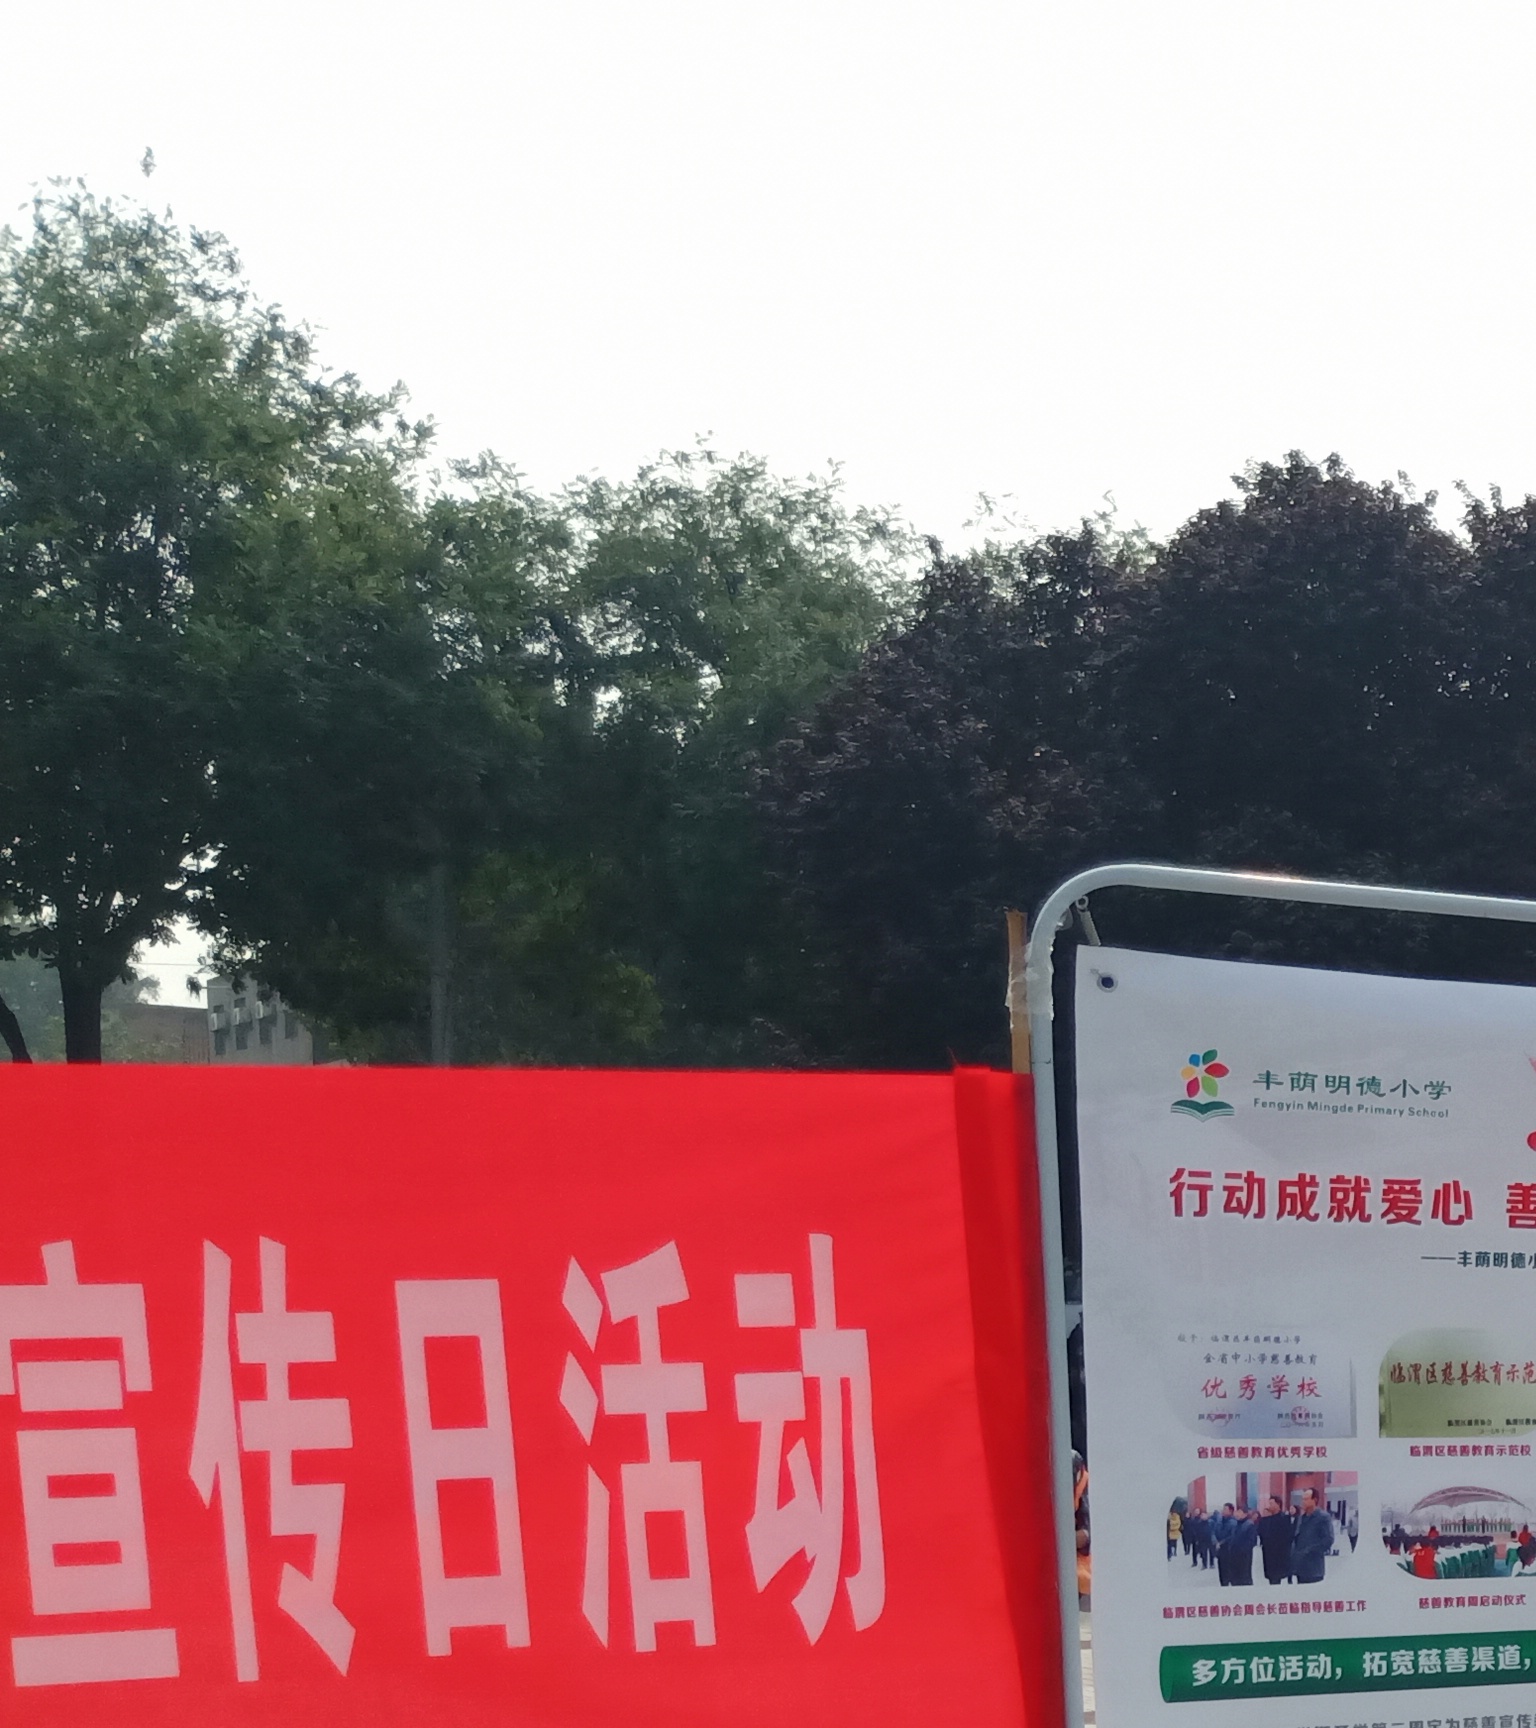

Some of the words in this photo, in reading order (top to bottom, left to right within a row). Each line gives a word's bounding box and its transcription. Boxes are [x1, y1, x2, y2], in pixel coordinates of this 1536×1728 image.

[1253, 1069, 1452, 1100] 丰荫明德小学
[1253, 1097, 1304, 1111] Fengyin
[1307, 1101, 1353, 1115] Mingde
[1357, 1104, 1404, 1118] Primary
[1408, 1106, 1449, 1118] School
[1169, 1167, 1473, 1226] 行动成就爱心
[1201, 1374, 1323, 1401] 优秀学校
[0, 1232, 886, 1688] 宣传日活动
